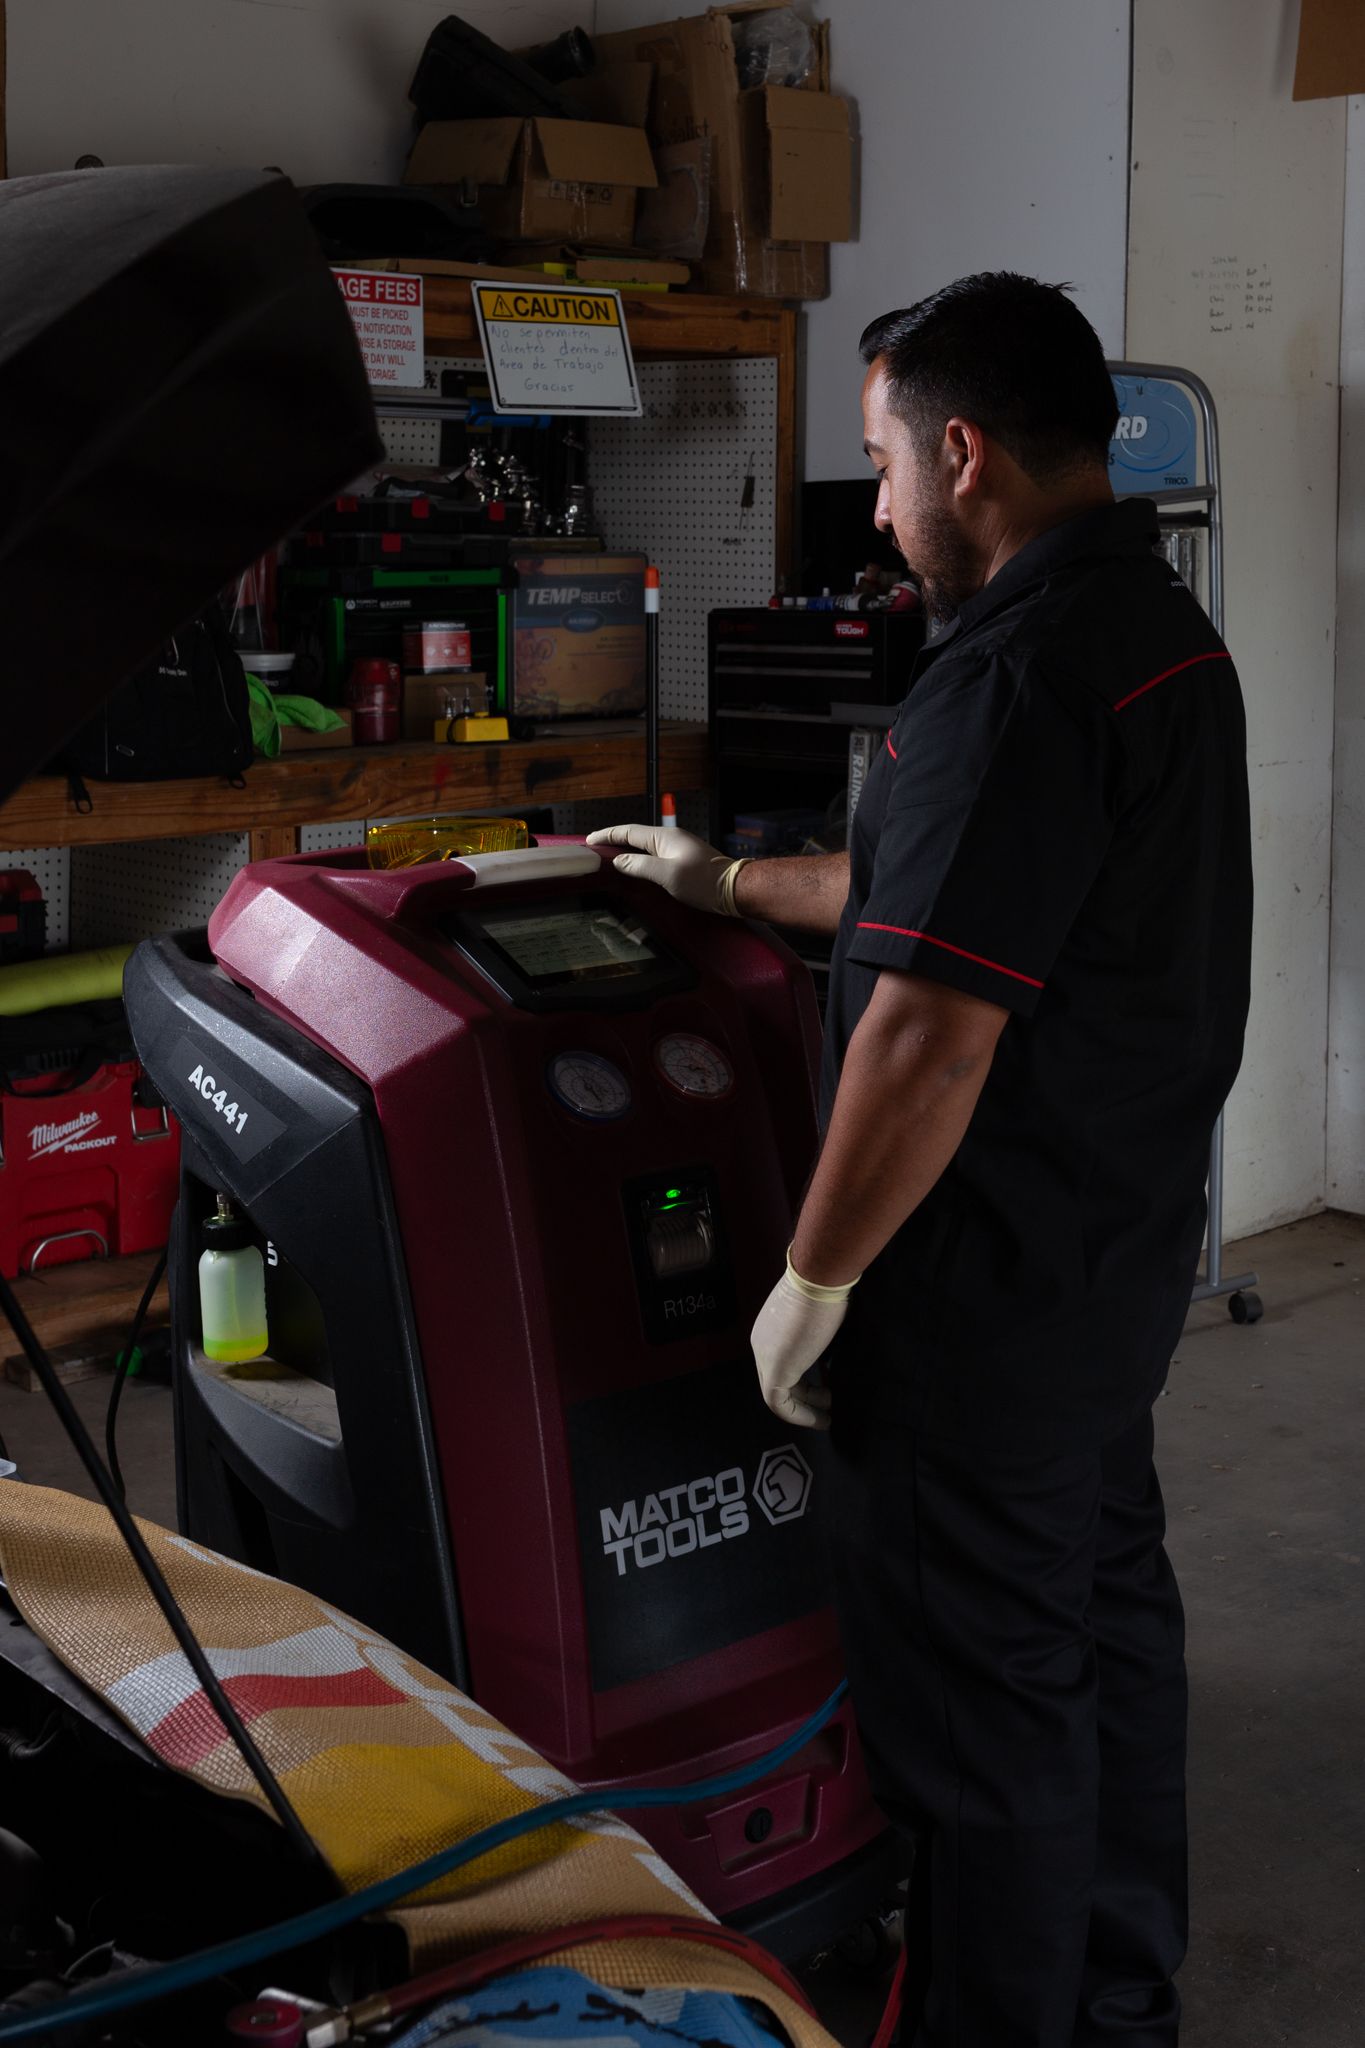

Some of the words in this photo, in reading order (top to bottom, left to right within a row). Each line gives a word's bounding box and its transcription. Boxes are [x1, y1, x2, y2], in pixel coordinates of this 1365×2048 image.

[375, 279, 418, 303] FEES
[371, 307, 381, 319] BE
[382, 308, 409, 321] PICKED
[513, 295, 611, 321] CAUTION
[363, 323, 412, 336] NOTIFICATION
[376, 339, 382, 349] A
[383, 339, 417, 352] STORAGE
[370, 353, 386, 365] DAY
[387, 354, 406, 367] WILL
[1111, 415, 1148, 441] RD
[1163, 476, 1189, 487] TRICO
[526, 586, 582, 606] TEMP
[187, 1063, 249, 1135] AC441
[27, 1111, 100, 1152] Milwaukee
[63, 1134, 118, 1154] PACKOUT
[663, 1293, 718, 1320] R134a
[599, 1465, 747, 1545] MATCO
[602, 1499, 751, 1578] TOOLS
